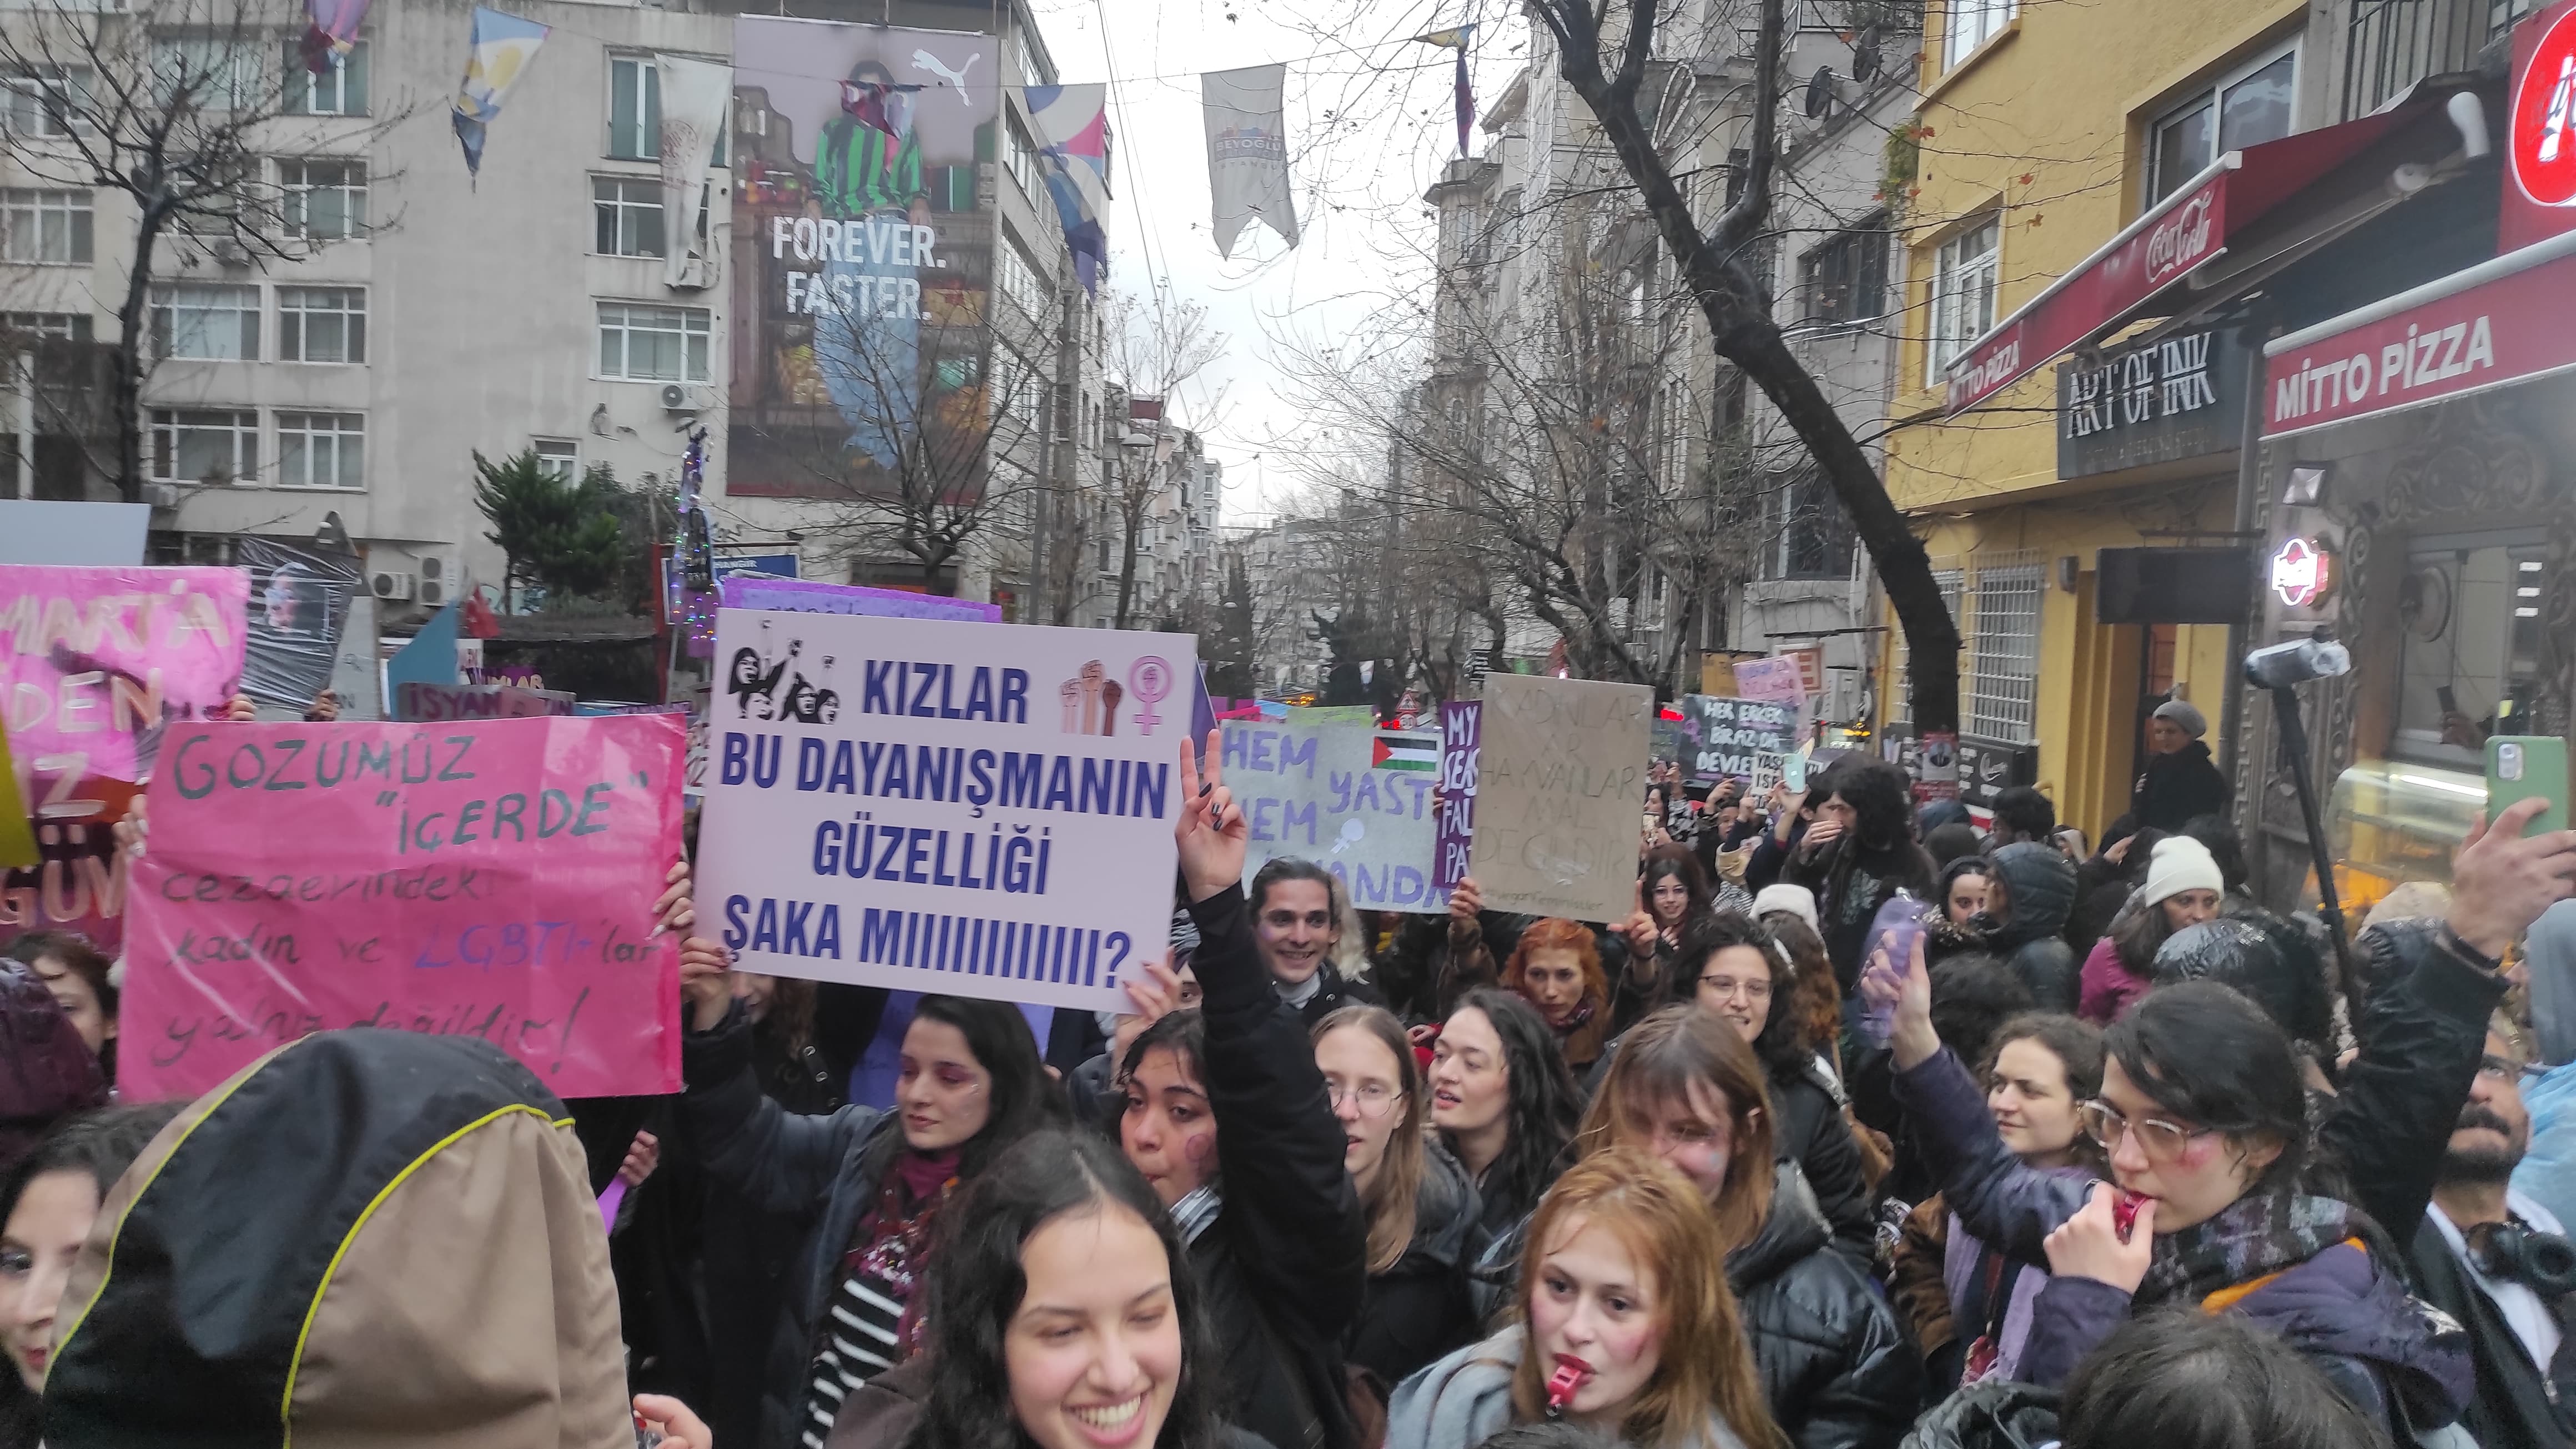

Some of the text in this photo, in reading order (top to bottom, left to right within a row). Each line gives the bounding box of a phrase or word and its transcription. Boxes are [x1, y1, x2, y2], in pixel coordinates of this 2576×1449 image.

[773, 216, 947, 268] FOREVER.
[786, 271, 933, 320] FASTER.
[2161, 332, 2216, 416] INK
[2275, 315, 2494, 422] MİTTO PİZZA
[863, 659, 1030, 724] KIZLAR
[1447, 705, 1478, 747] MY
[721, 732, 783, 788] BU
[796, 736, 1169, 819] DAYANIŞMANIN
[1222, 727, 1318, 778] HEM
[1696, 752, 1752, 776] DEVLE
[1326, 771, 1436, 821] YAST
[814, 811, 1051, 895] GÜZELLİĞİ
[1445, 843, 1472, 883] PA
[339, 936, 384, 963] ve
[723, 895, 842, 962] ŞAKA
